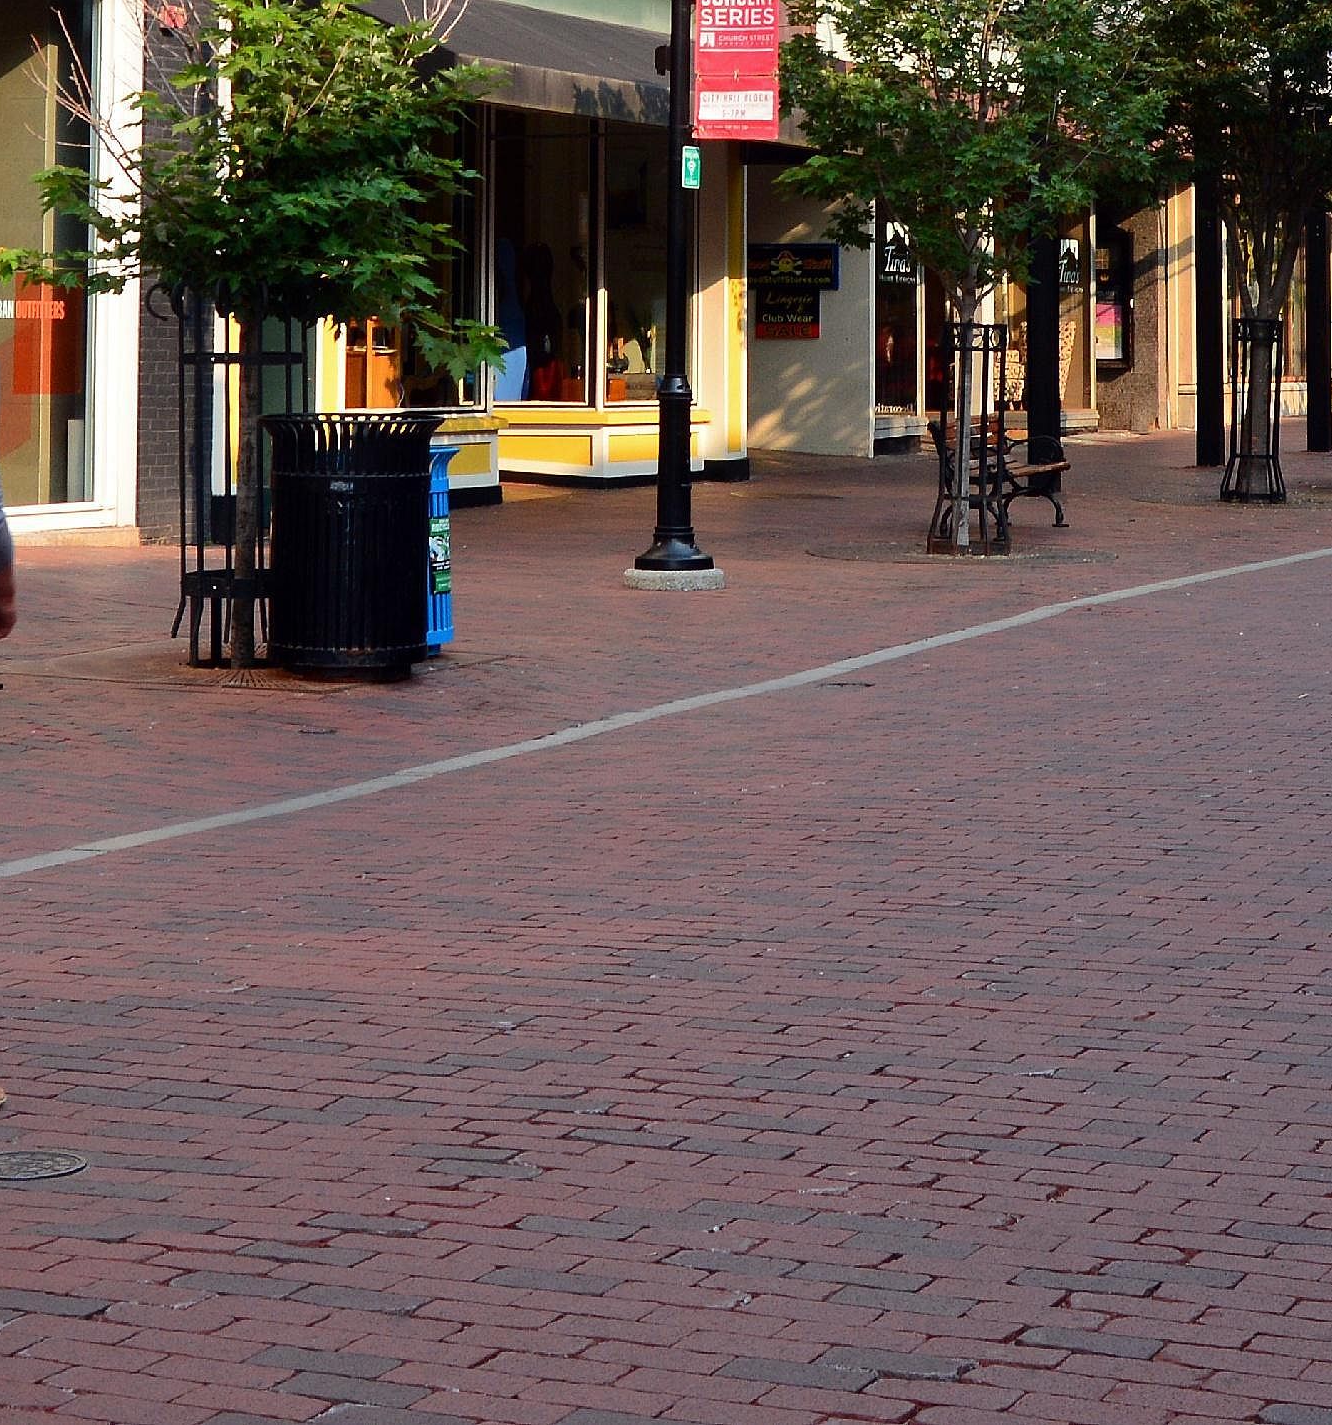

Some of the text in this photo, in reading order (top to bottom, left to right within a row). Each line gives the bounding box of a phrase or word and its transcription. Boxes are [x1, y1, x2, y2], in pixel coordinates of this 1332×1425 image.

[700, 8, 775, 26] SERIES
[15, 300, 66, 320] OUTFITTERS
[762, 313, 815, 323] Club Wear
[765, 324, 811, 337] SALE
